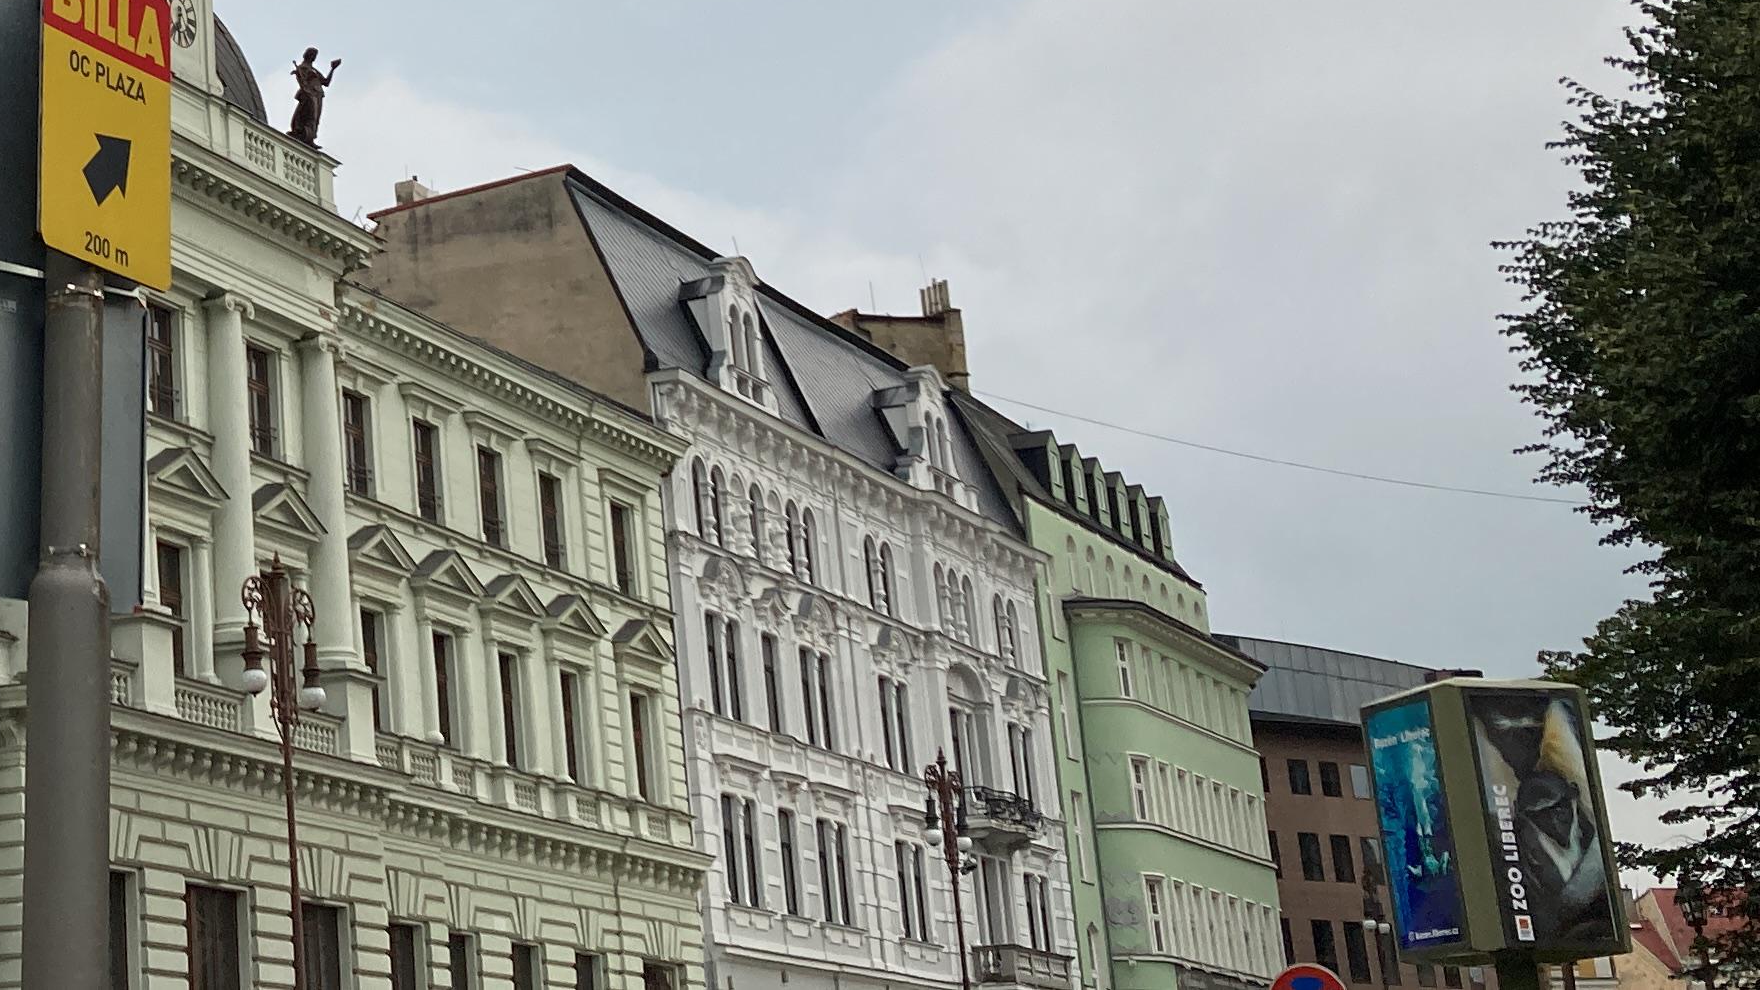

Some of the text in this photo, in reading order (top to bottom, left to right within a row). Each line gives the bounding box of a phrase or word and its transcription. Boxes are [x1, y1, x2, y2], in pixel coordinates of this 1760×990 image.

[69, 50, 146, 105] OC PLAZA
[85, 231, 128, 267] 200 m
[1493, 784, 1519, 862] LIBEREC
[1508, 867, 1528, 910] ZOO
